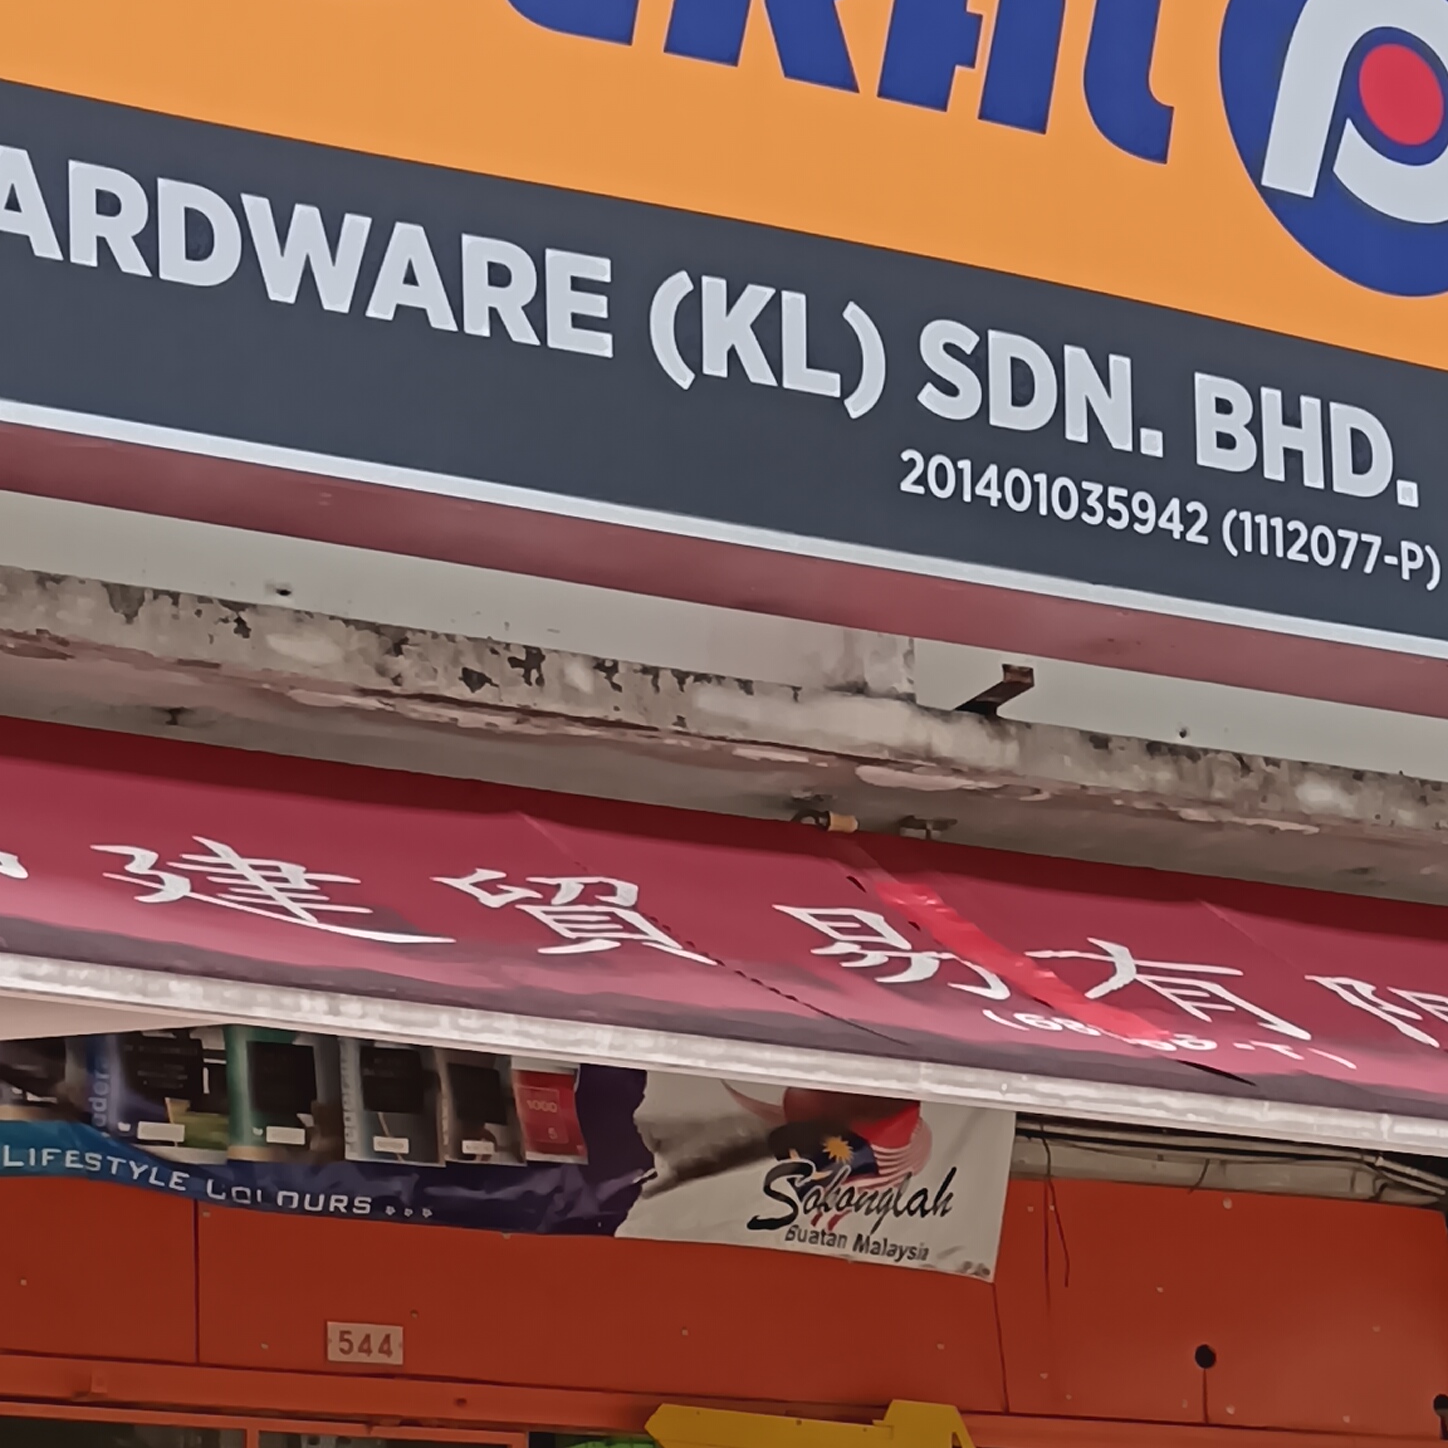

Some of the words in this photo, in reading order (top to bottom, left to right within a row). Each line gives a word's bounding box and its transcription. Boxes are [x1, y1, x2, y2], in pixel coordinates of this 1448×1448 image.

[648, 269, 887, 420] (KL)
[916, 318, 1165, 459] SDN.
[1193, 370, 1421, 509] BHD.
[899, 448, 1210, 546] 201401035942
[1221, 508, 1443, 592] (1112077-P)
[3, 1145, 188, 1192] LIFESTYLE
[784, 1224, 849, 1250] Buatan
[338, 1329, 394, 1359] 544
